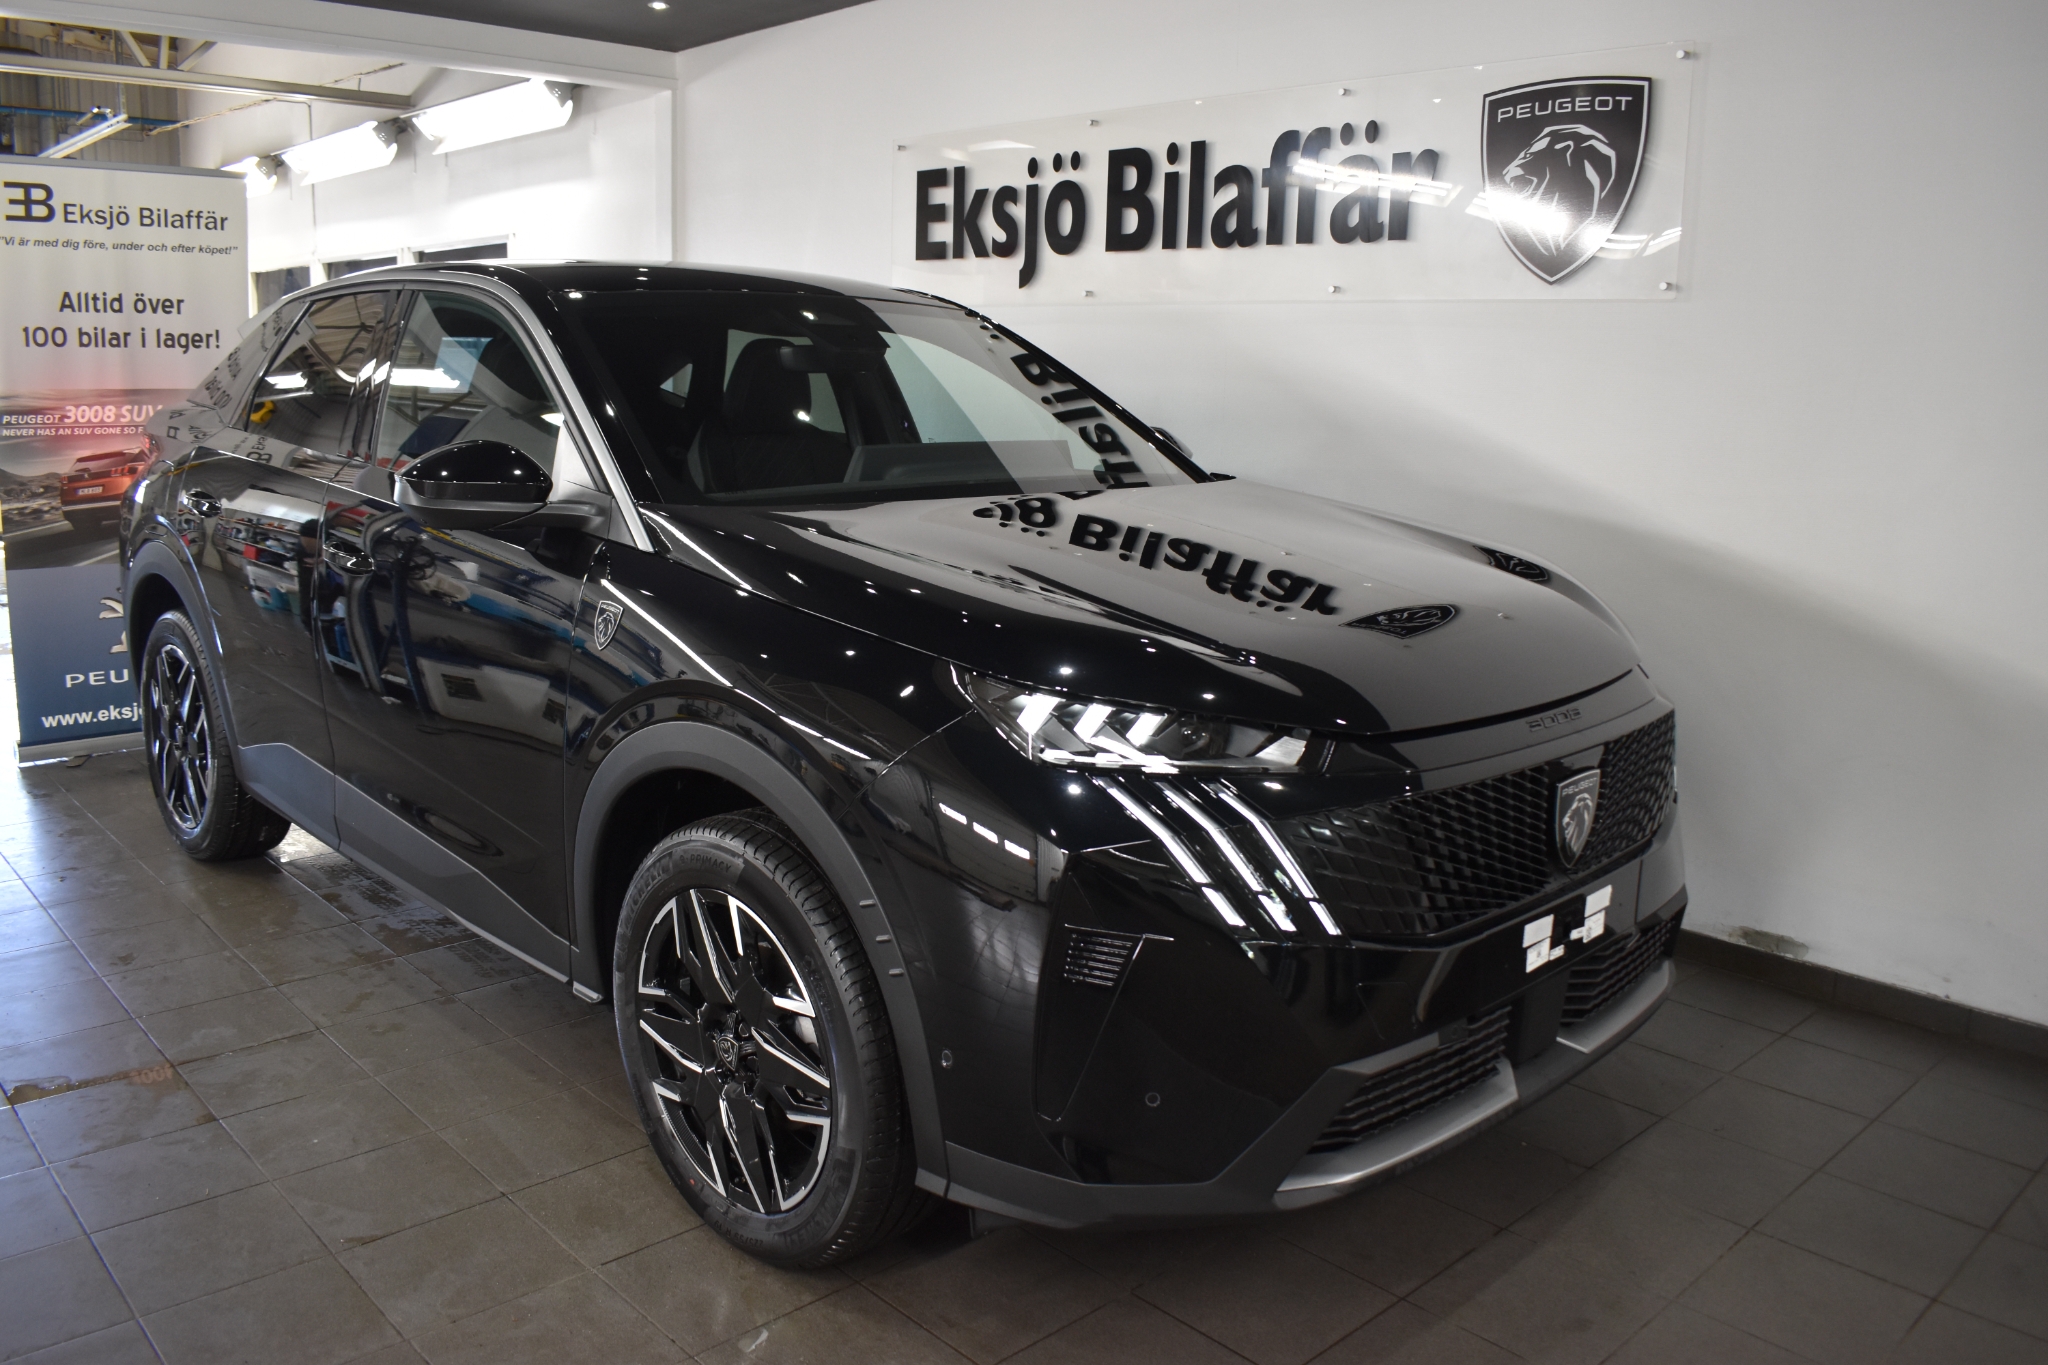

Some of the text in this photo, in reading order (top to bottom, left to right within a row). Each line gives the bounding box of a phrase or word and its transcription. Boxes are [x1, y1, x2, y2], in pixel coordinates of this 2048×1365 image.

[1497, 96, 1633, 123] PEUGEOT
[916, 119, 1440, 289] Eksjö Bilaffär
[63, 203, 228, 231] Eksjö Bilaffär
[18, 236, 31, 247] är
[33, 237, 59, 248] med
[62, 238, 80, 251] dig
[83, 239, 109, 251] före,
[112, 241, 144, 252] under
[148, 242, 168, 253] och
[171, 243, 196, 254] efter
[59, 291, 185, 315] Alltid över
[23, 327, 220, 355] 100 bilar i lager!
[3, 404, 163, 425] PEUGEOT 3008 SUV
[3, 428, 35, 437] NEVER
[37, 427, 56, 436] HAS
[58, 427, 72, 436] AN
[74, 427, 93, 436] SUV
[94, 427, 122, 435] GONE
[123, 426, 135, 435] SO
[65, 668, 129, 688] PEU
